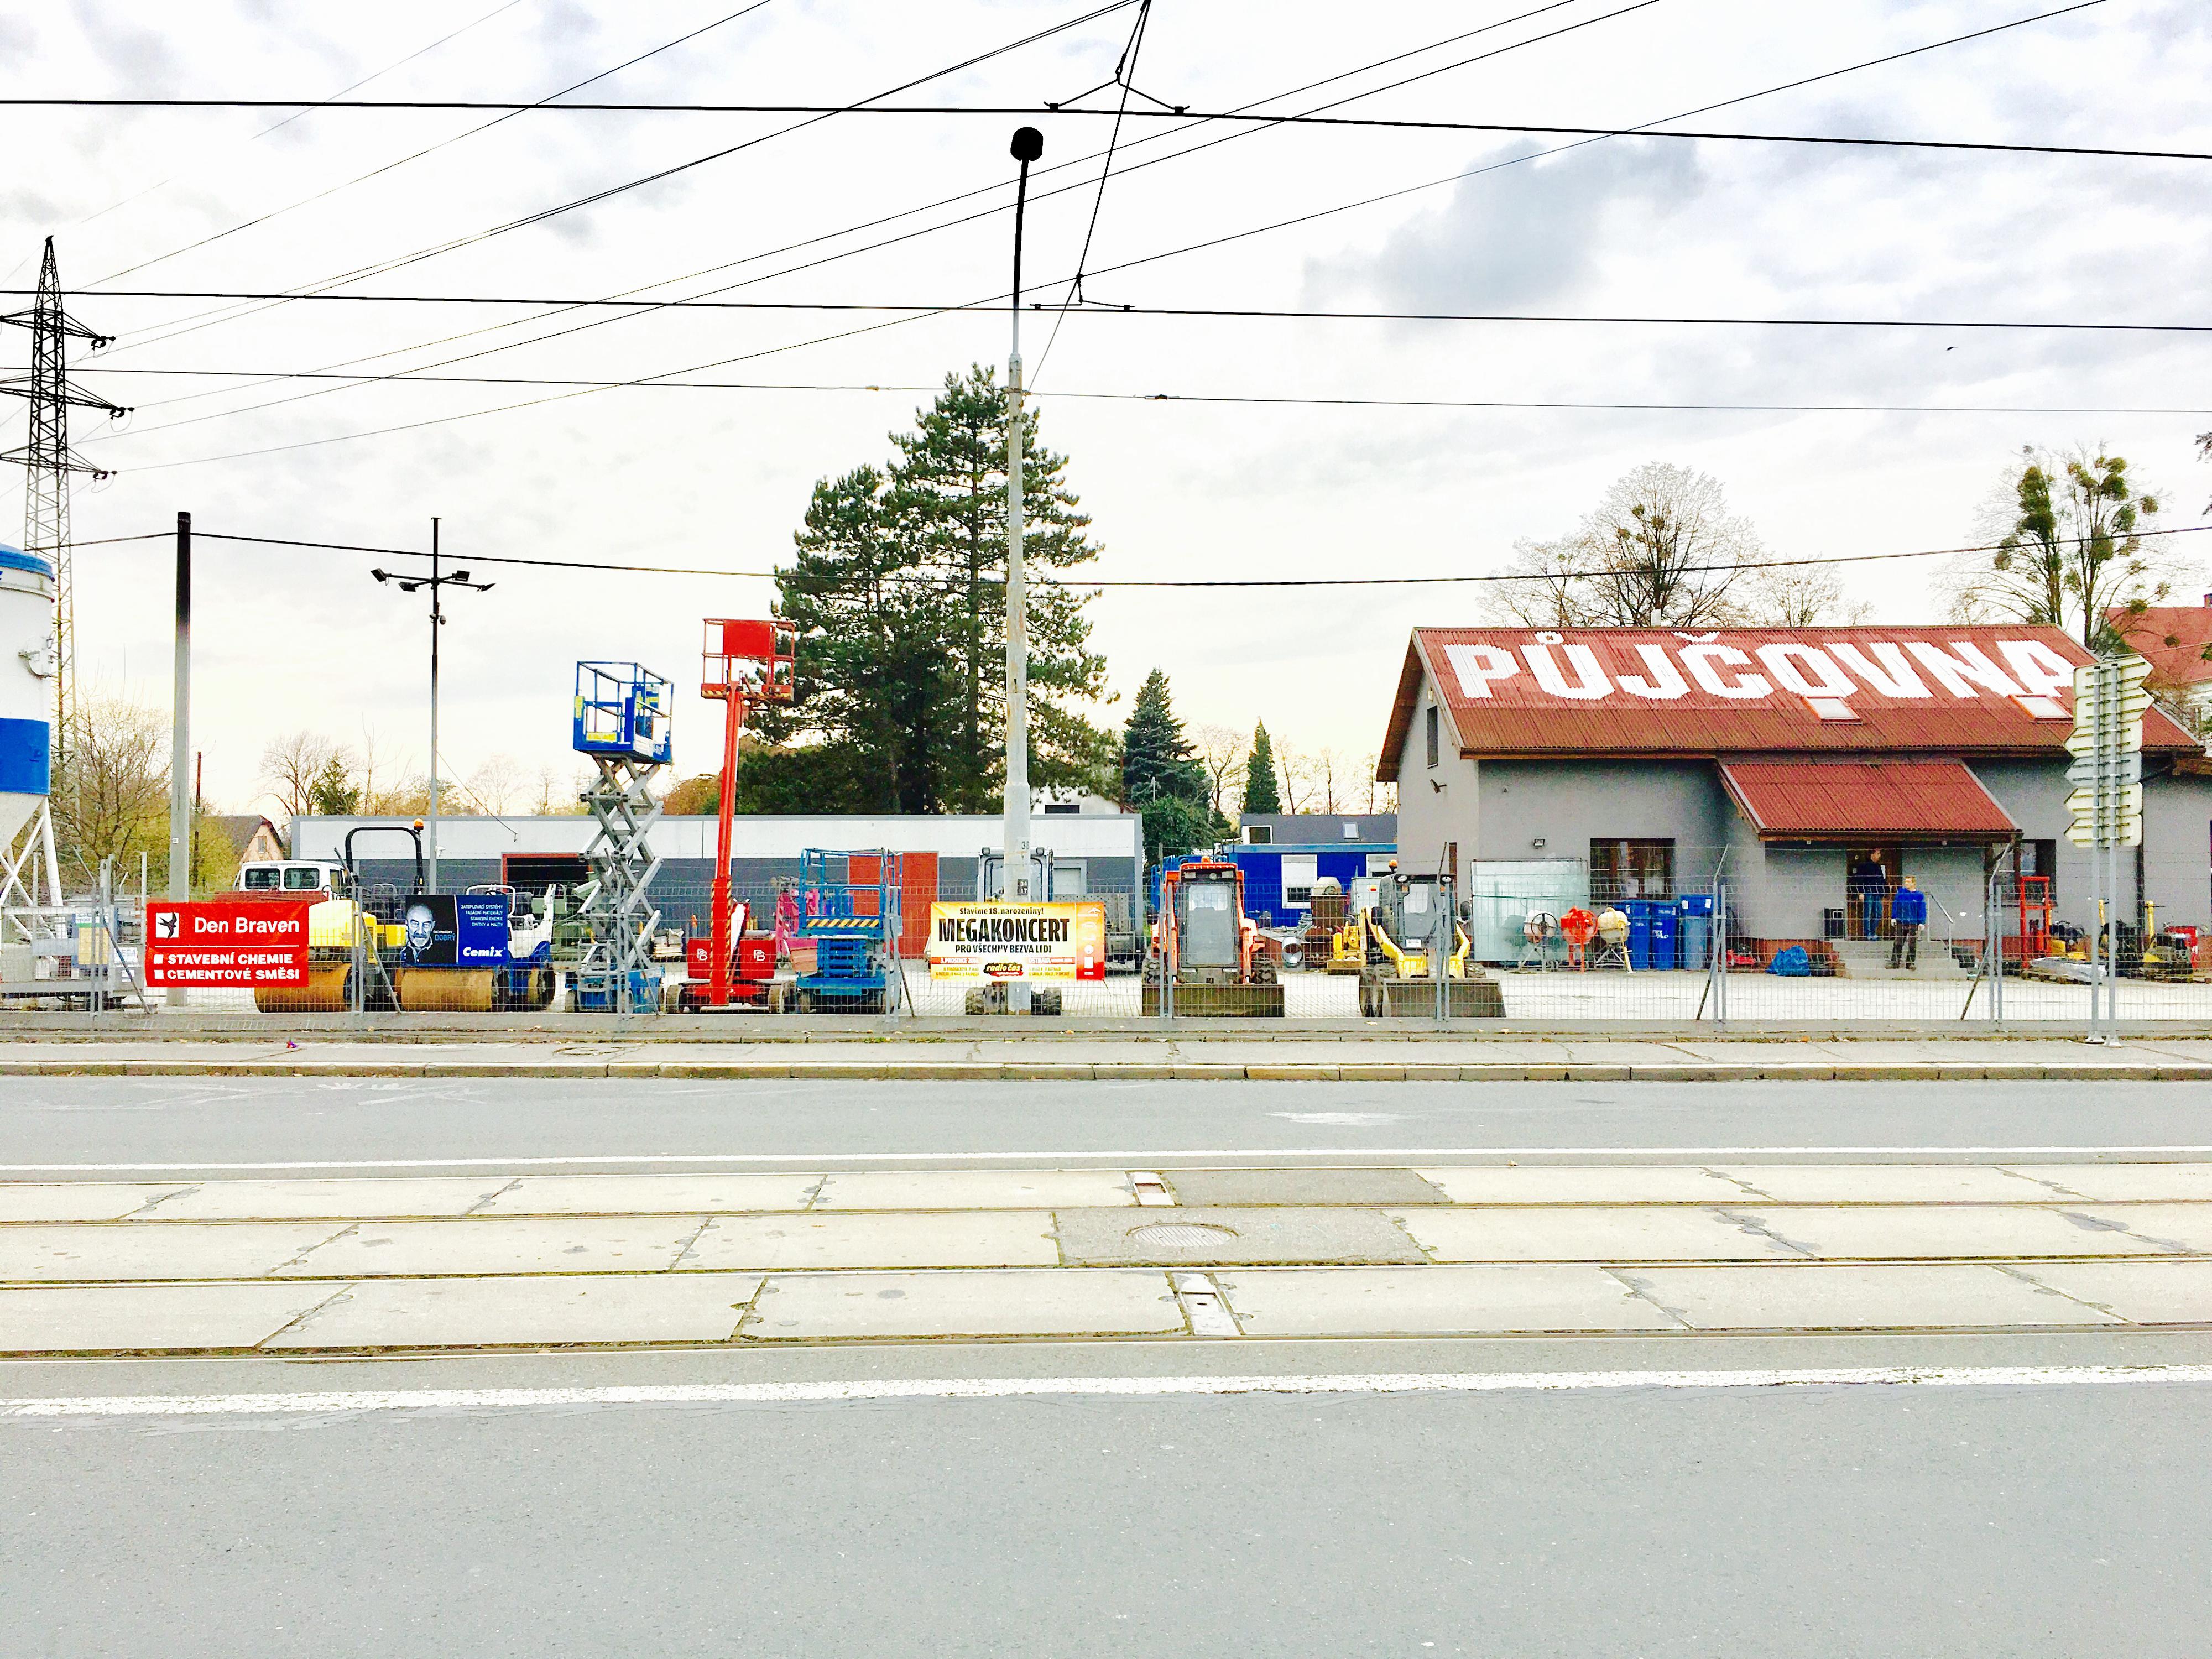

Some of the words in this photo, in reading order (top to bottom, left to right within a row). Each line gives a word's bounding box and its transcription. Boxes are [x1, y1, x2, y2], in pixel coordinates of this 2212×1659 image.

[1442, 630, 2075, 700] PŮJČOVNA
[1000, 907, 1044, 916] narozeniny!
[194, 917, 229, 933] Den
[235, 917, 299, 933] Braven
[938, 918, 1070, 942] MEGAKONCERT
[462, 946, 503, 957] Cemix
[955, 945, 972, 953] PRO
[973, 943, 1008, 953] VŠECHNY
[1009, 945, 1034, 953] BEZVA
[1035, 945, 1052, 953] LIDI
[168, 952, 235, 964] STAVEBNÍ
[238, 953, 293, 964] CHEMIE
[167, 968, 252, 980] CEMENTOVÉ
[255, 967, 299, 979] SMĚSI
